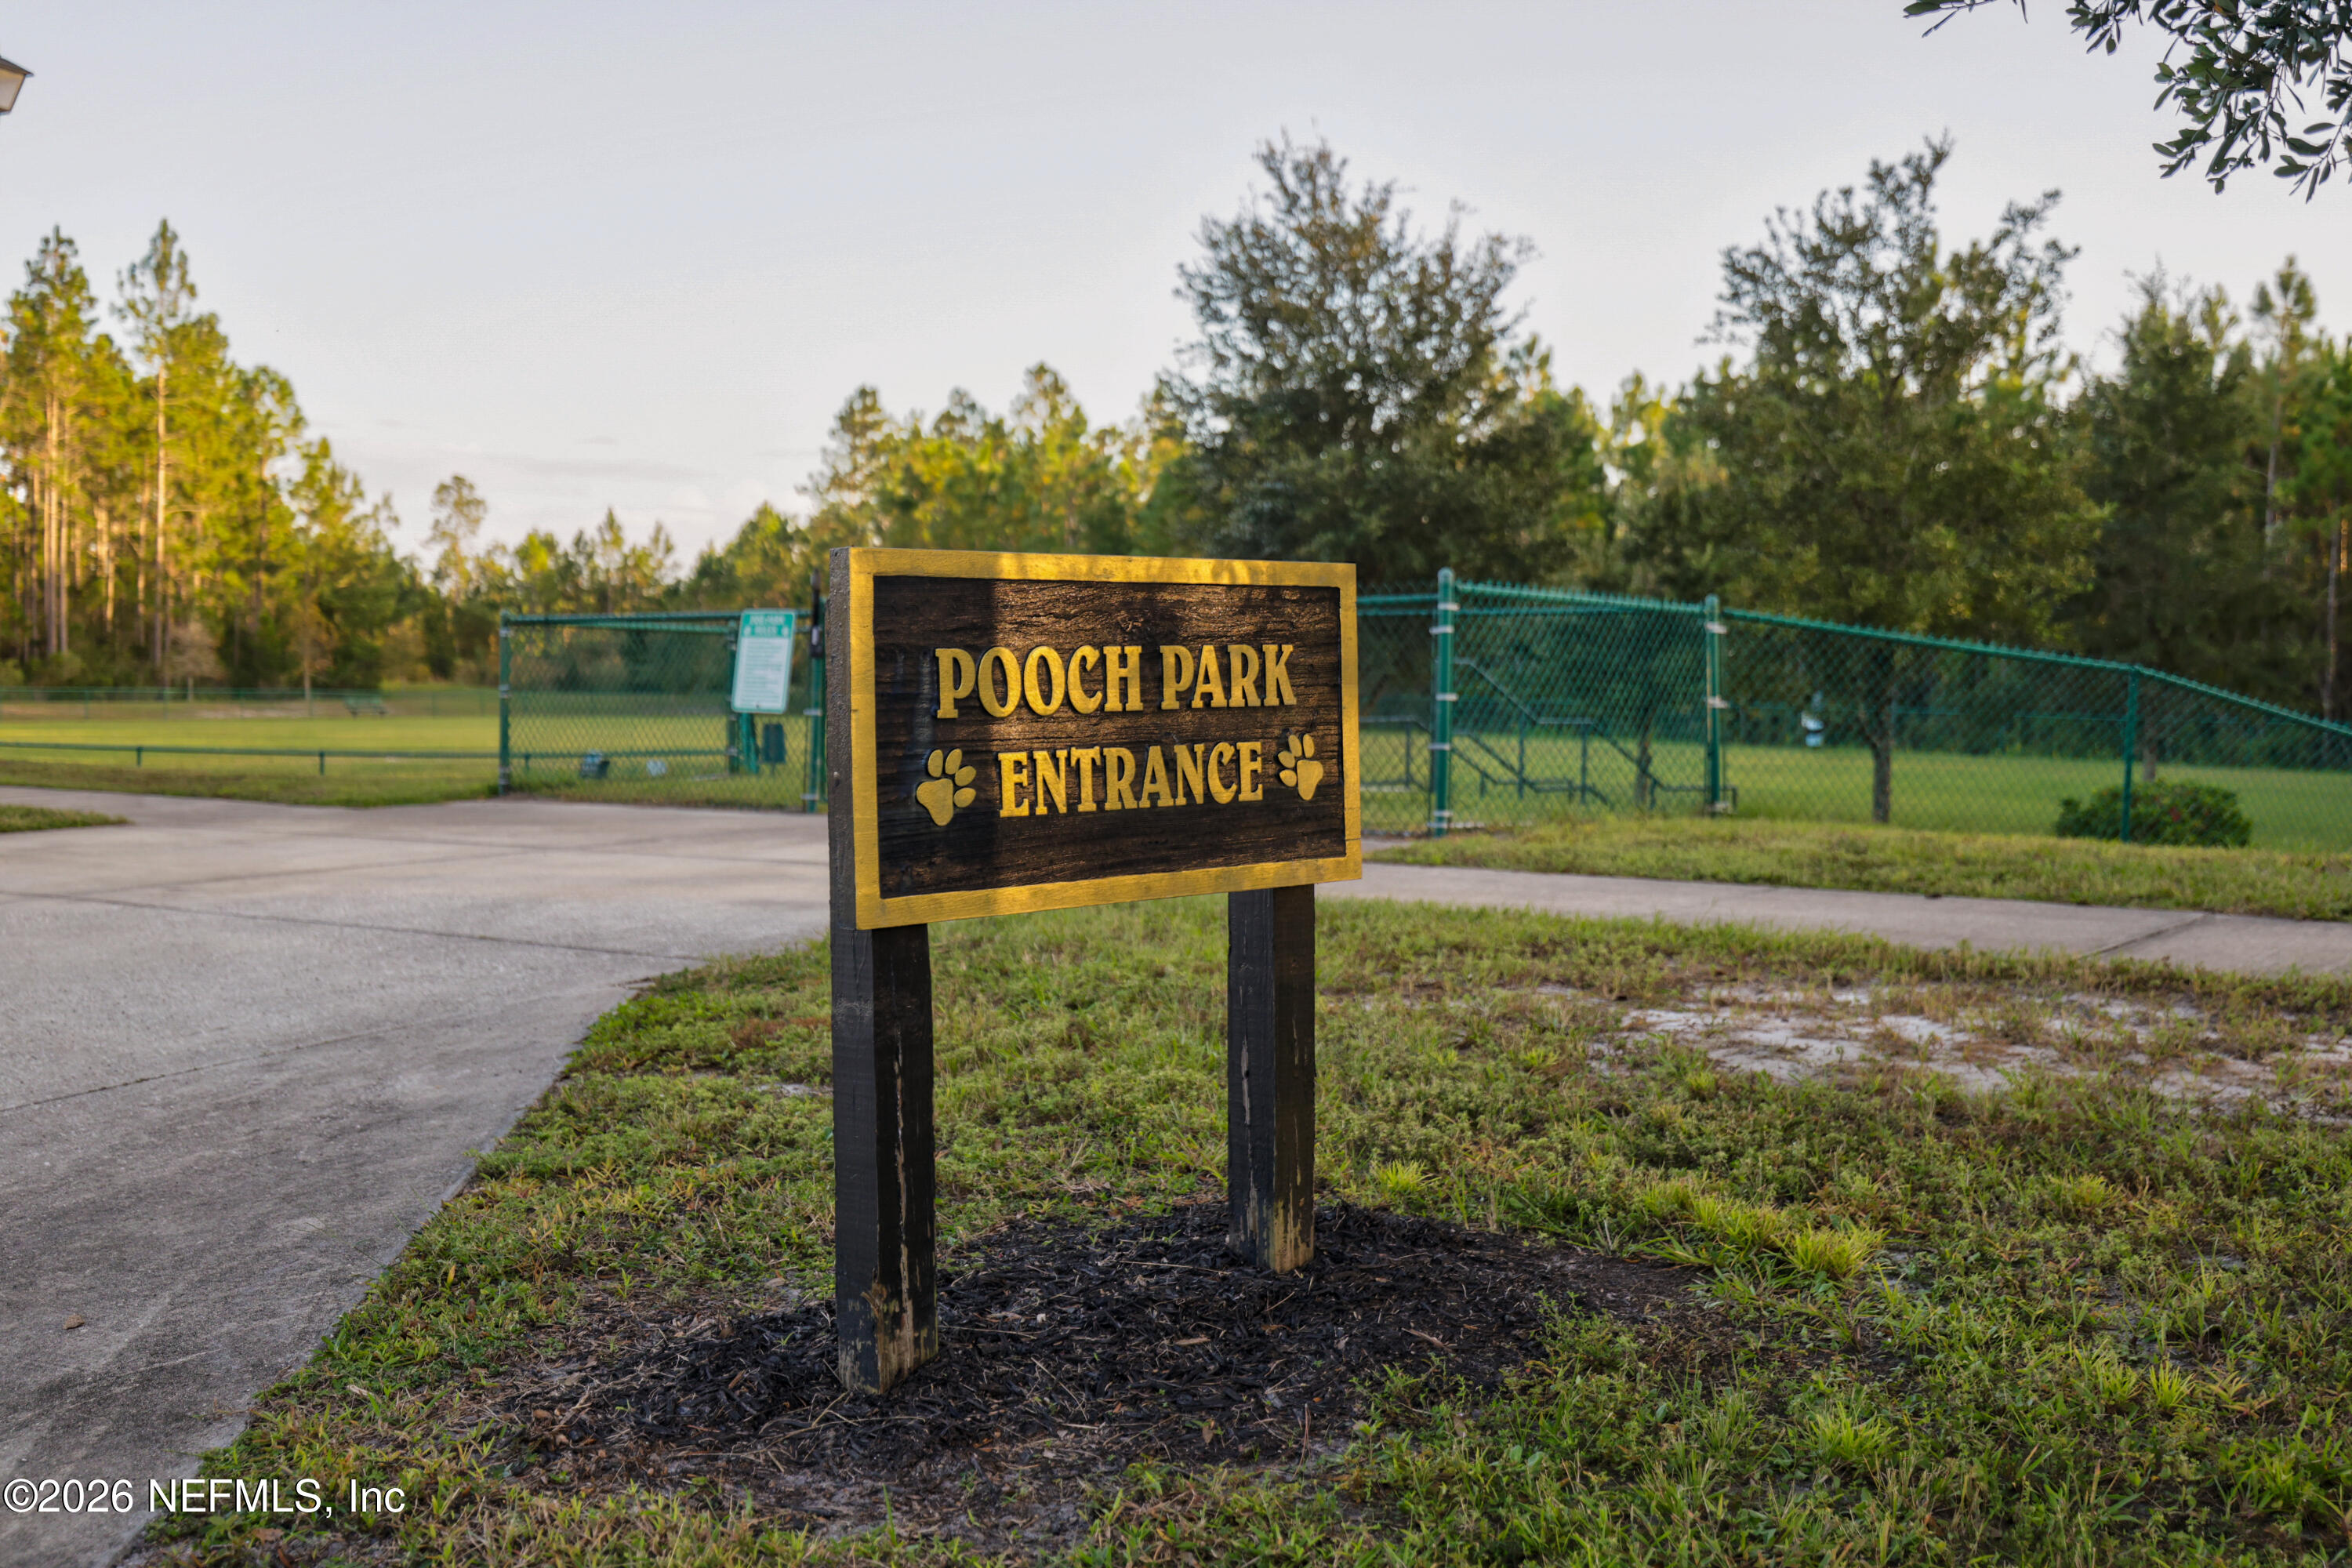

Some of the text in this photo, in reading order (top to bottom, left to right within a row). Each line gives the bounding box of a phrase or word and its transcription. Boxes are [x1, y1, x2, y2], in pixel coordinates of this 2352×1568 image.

[935, 644, 1298, 719] POOCH PARK
[997, 741, 1264, 818] ENTRANCE
